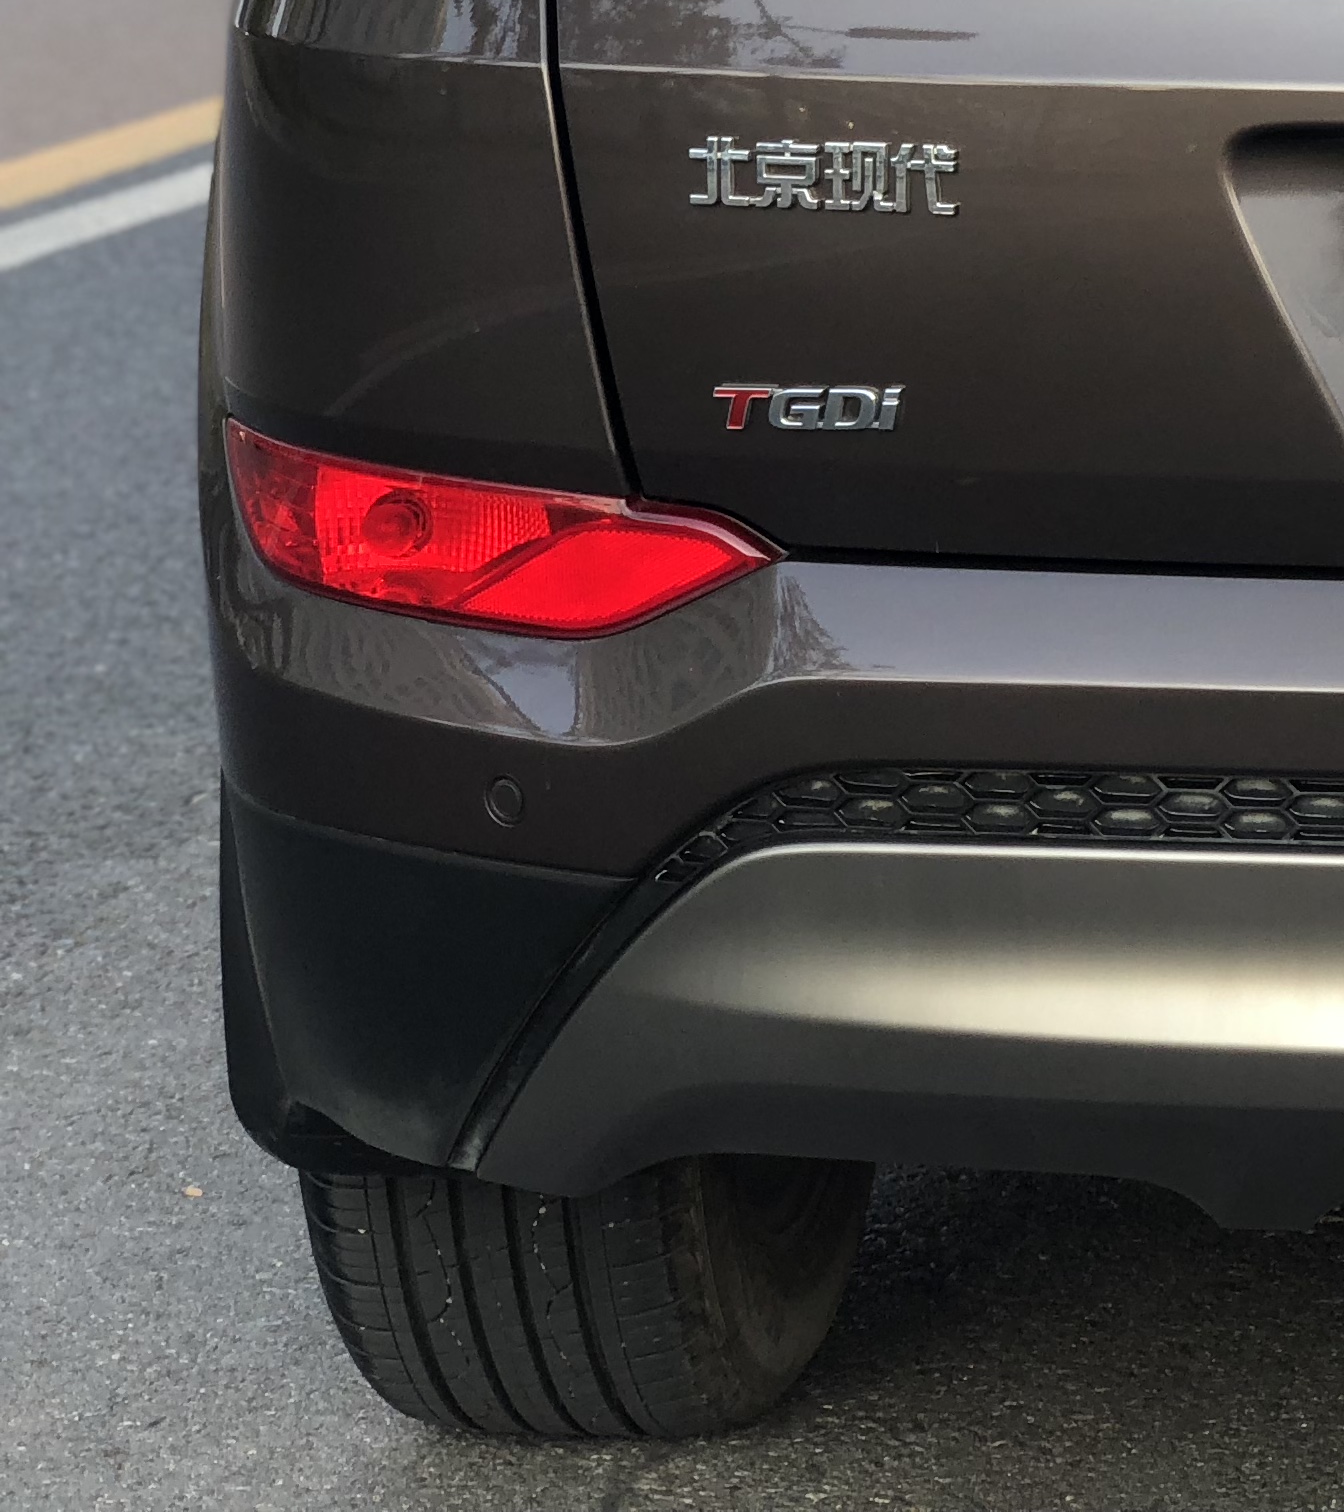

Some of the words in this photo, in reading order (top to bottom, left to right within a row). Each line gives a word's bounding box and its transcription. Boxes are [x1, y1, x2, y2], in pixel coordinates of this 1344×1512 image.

[688, 135, 961, 216] 北京现代
[712, 383, 906, 430] TGDi
